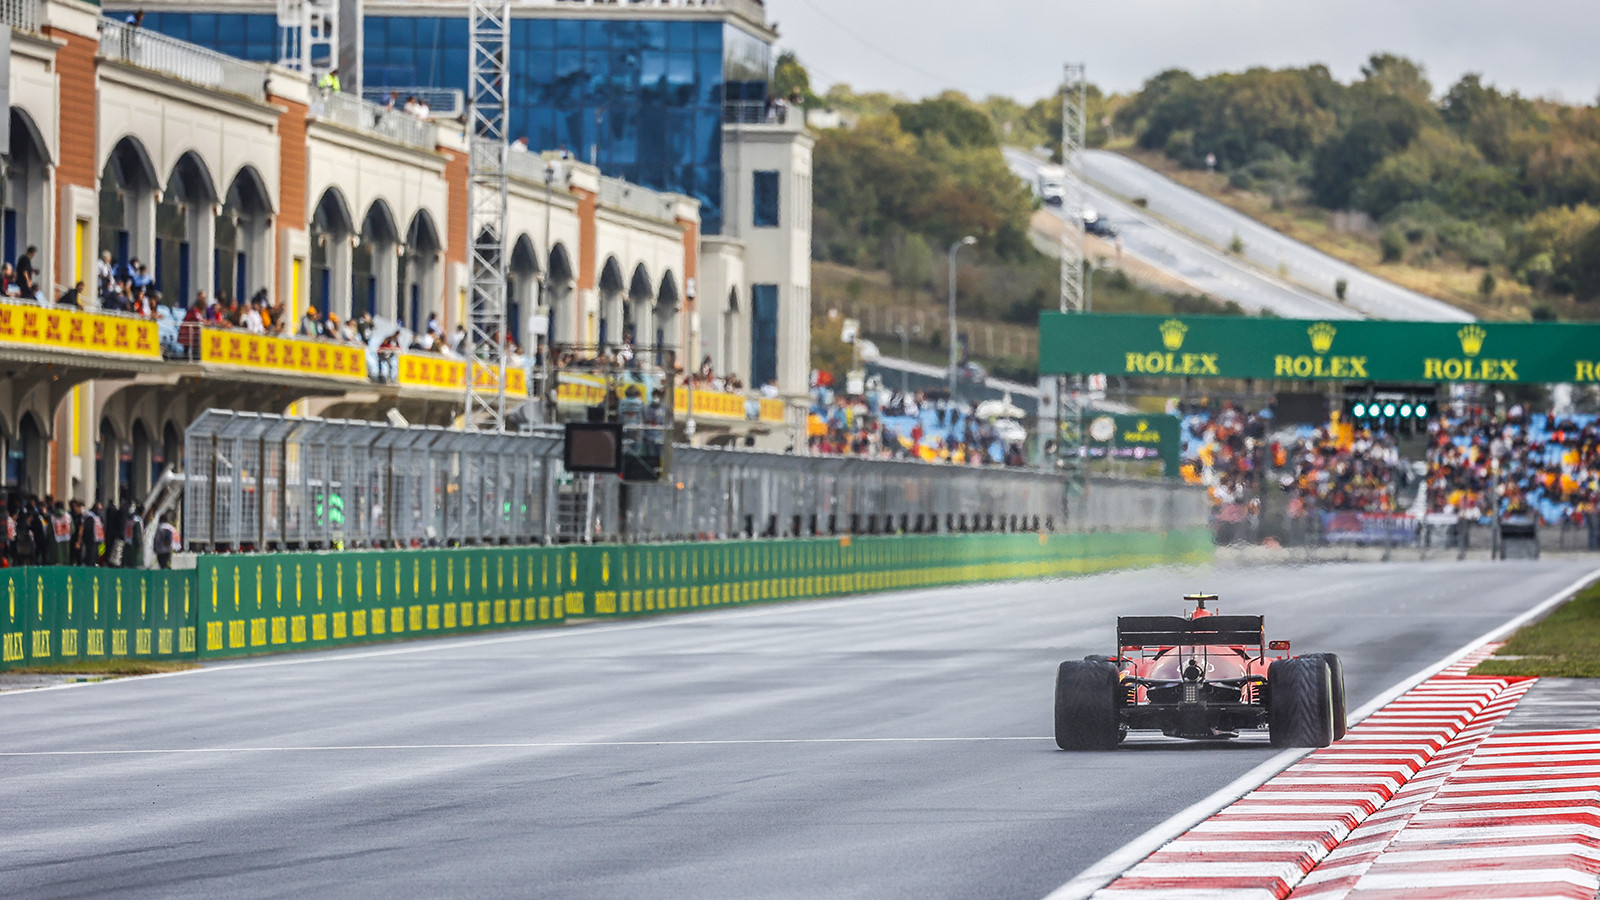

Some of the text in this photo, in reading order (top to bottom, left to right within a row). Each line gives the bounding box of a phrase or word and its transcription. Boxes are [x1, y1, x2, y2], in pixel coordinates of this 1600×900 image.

[1125, 352, 1219, 376] ROLEX
[1274, 355, 1368, 378] ROLEX
[1423, 358, 1518, 381] ROLEX
